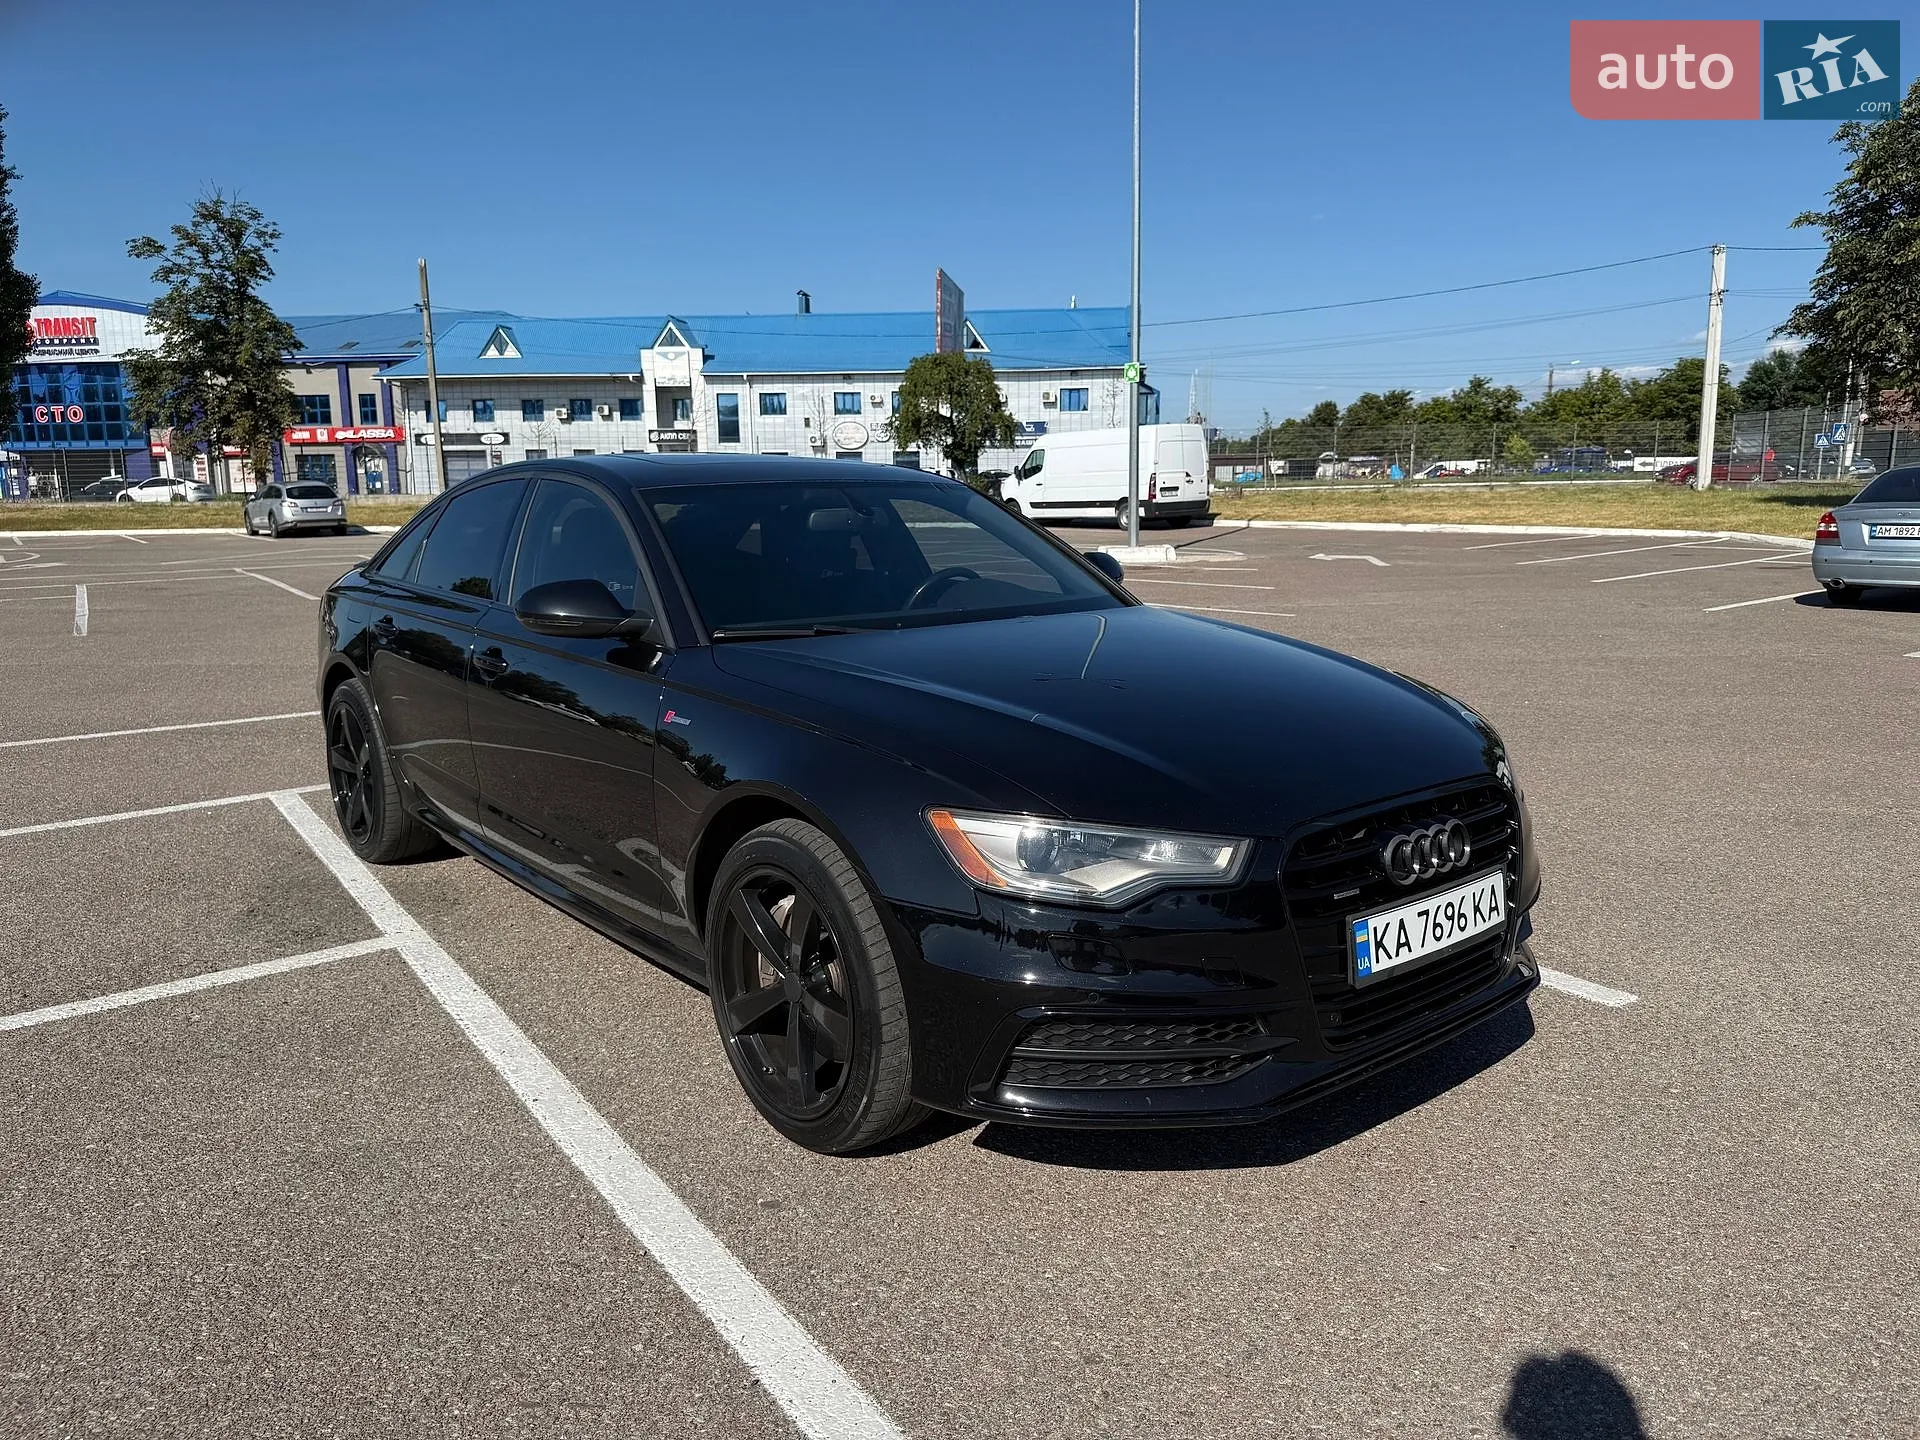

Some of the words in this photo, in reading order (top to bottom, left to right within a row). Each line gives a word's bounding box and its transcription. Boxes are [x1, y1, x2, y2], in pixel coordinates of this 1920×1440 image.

[34, 316, 97, 337] TRANSIT
[35, 405, 84, 423] СТО
[1877, 526, 1892, 536] AM
[1893, 526, 1916, 536] 1892
[1373, 918, 1412, 964] KA
[1417, 895, 1468, 948] 7696
[1472, 884, 1500, 927] KA
[1358, 957, 1371, 970] UA
